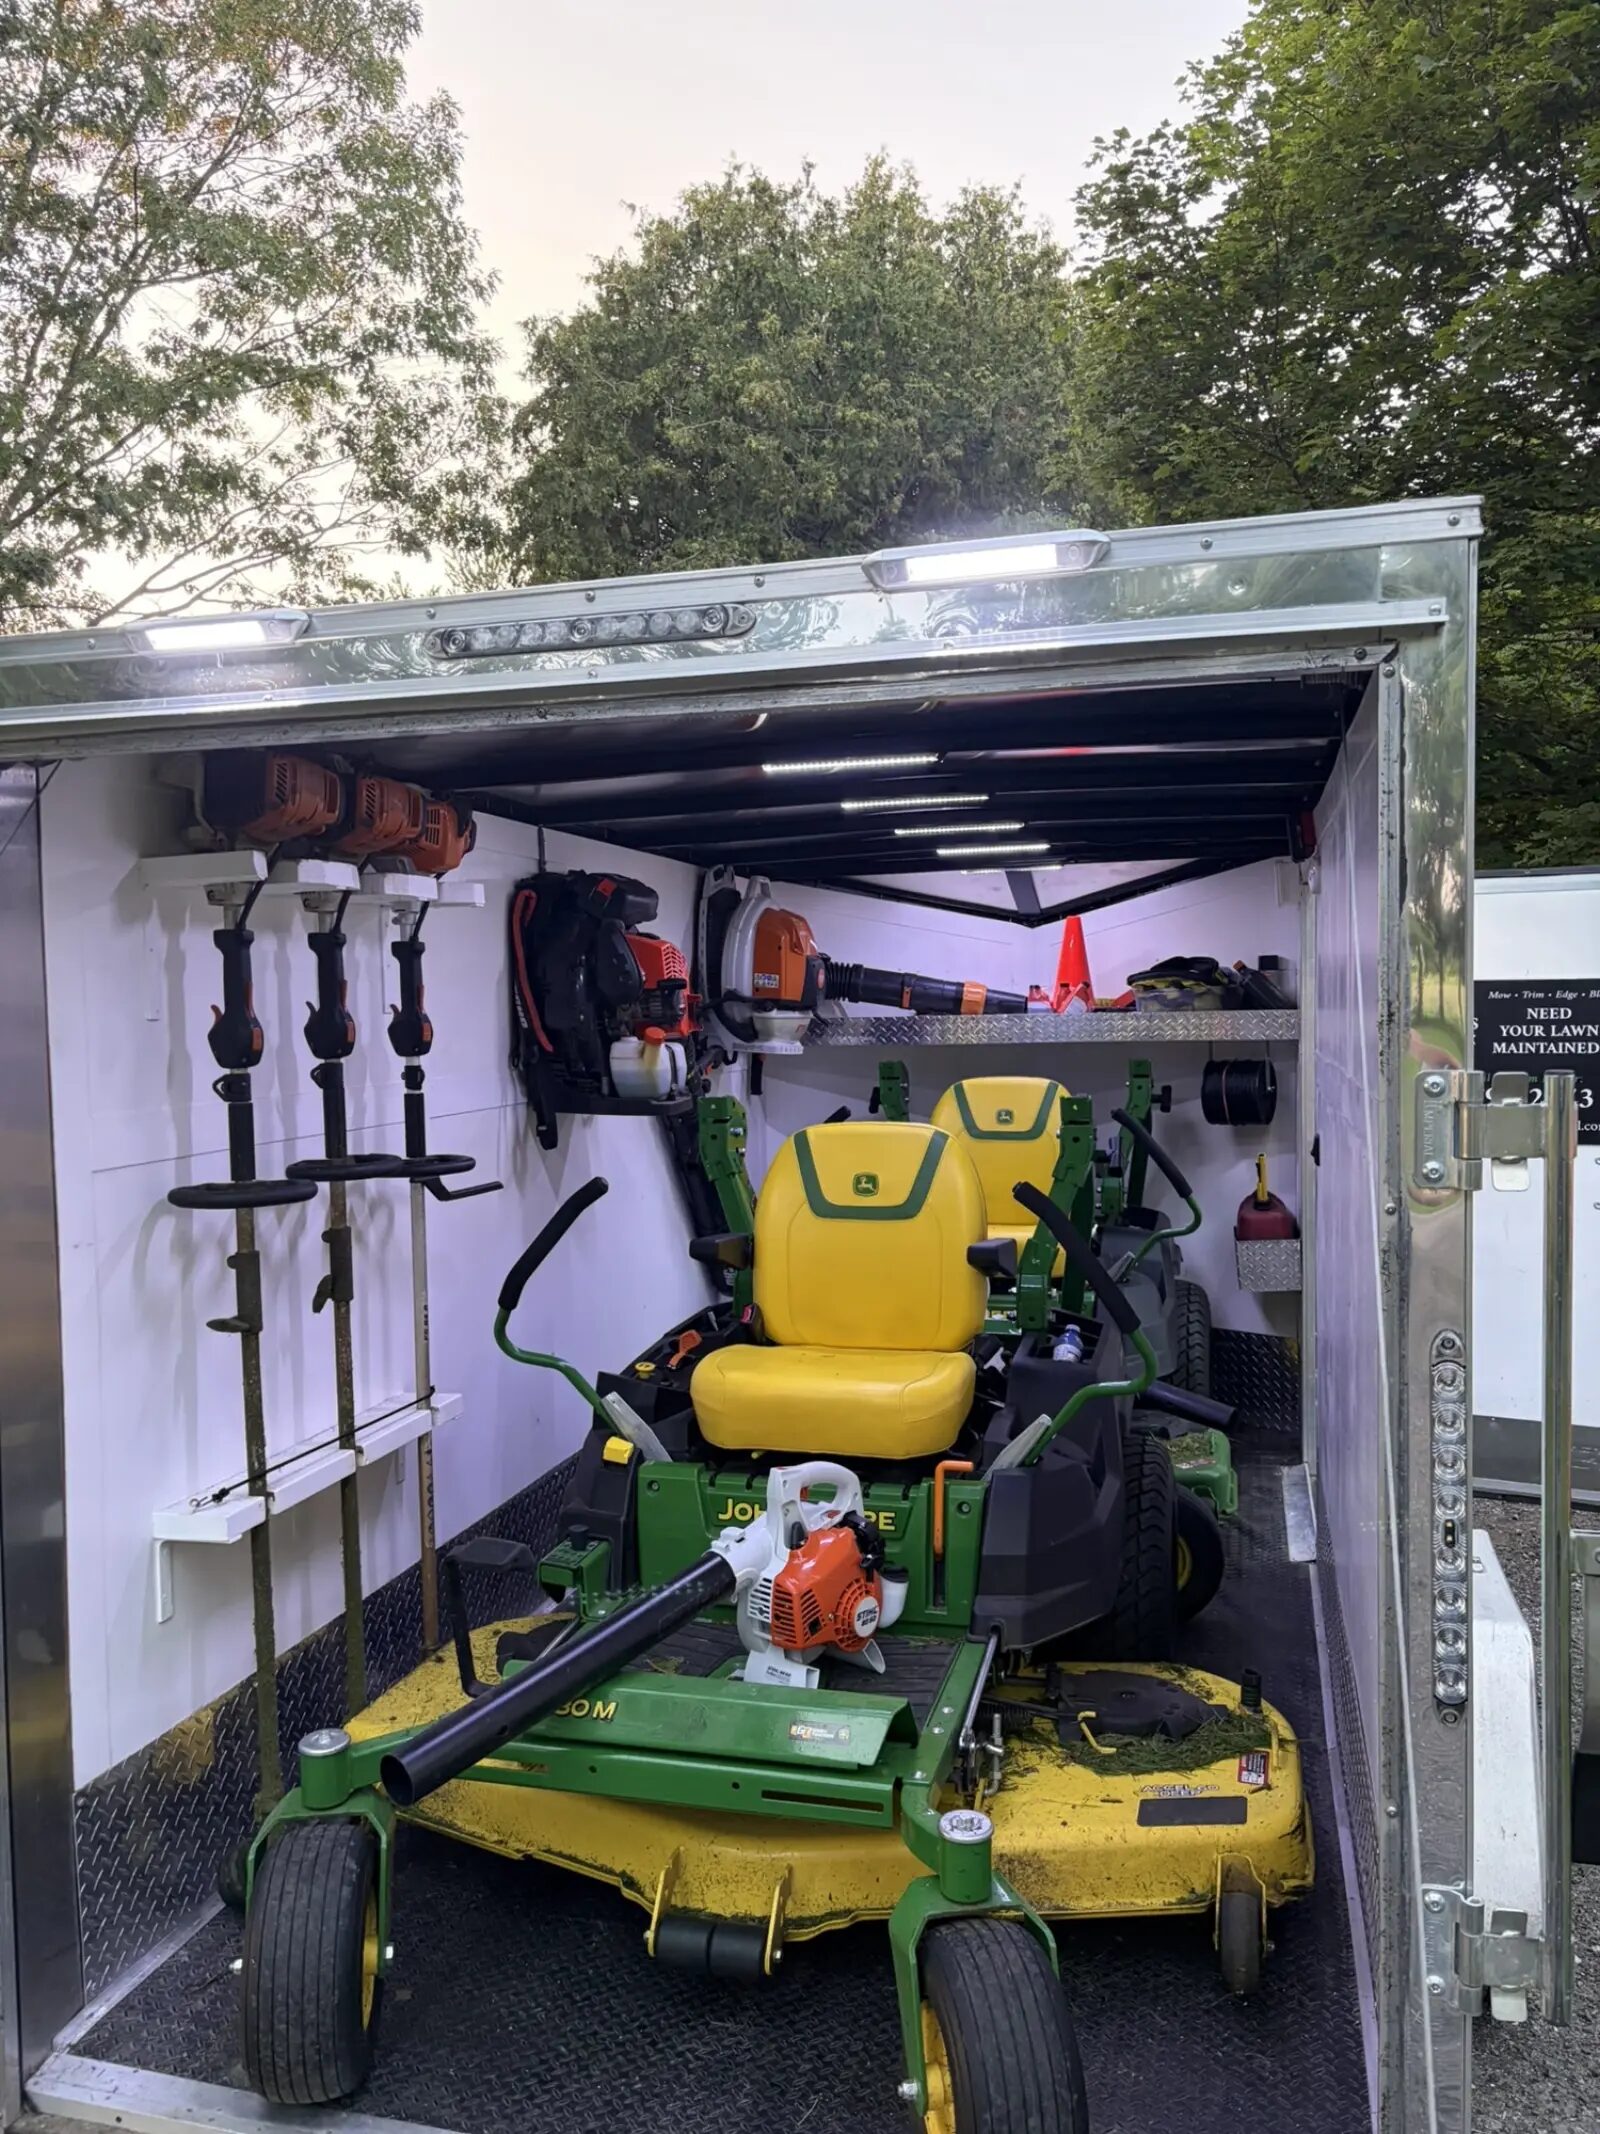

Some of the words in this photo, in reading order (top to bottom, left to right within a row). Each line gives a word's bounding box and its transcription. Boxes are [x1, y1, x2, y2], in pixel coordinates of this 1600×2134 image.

[1488, 991, 1512, 999] Mow
[1523, 990, 1545, 999] Trim
[1556, 989, 1578, 1000] Edge
[1526, 1007, 1572, 1020] NEED
[1499, 1024, 1546, 1037] YOUR
[1550, 1024, 1599, 1037] LAWN
[1492, 1042, 1600, 1054] MAINTAINED
